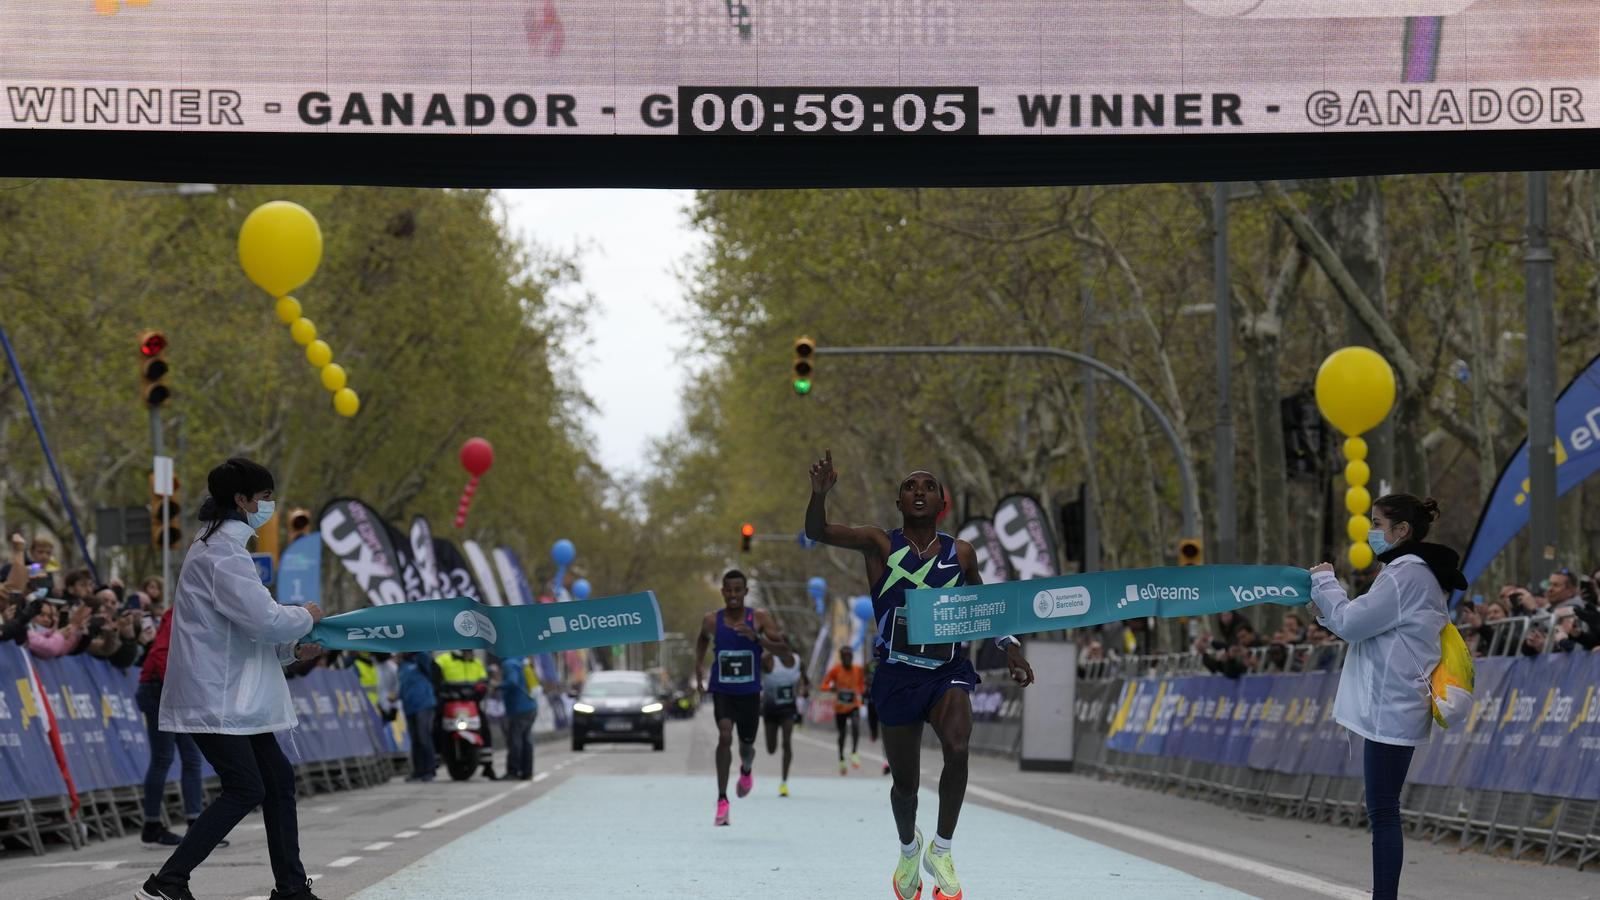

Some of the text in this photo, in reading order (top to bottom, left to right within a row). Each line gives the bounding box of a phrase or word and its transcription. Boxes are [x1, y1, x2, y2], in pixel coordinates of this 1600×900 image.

[6, 86, 245, 126] WINNER
[297, 91, 579, 128] GANADOR
[690, 93, 967, 132] 00:59:05
[1017, 92, 1244, 128] WINNER
[1305, 87, 1585, 127] GANADOR
[949, 594, 978, 603] eDreams
[1140, 583, 1200, 601] eDreams
[933, 605, 968, 622] MITJA
[1055, 600, 1084, 609] Barcelona
[569, 611, 642, 631] eDreams
[934, 618, 992, 637] BARCELONA
[346, 624, 406, 641] 2XU
